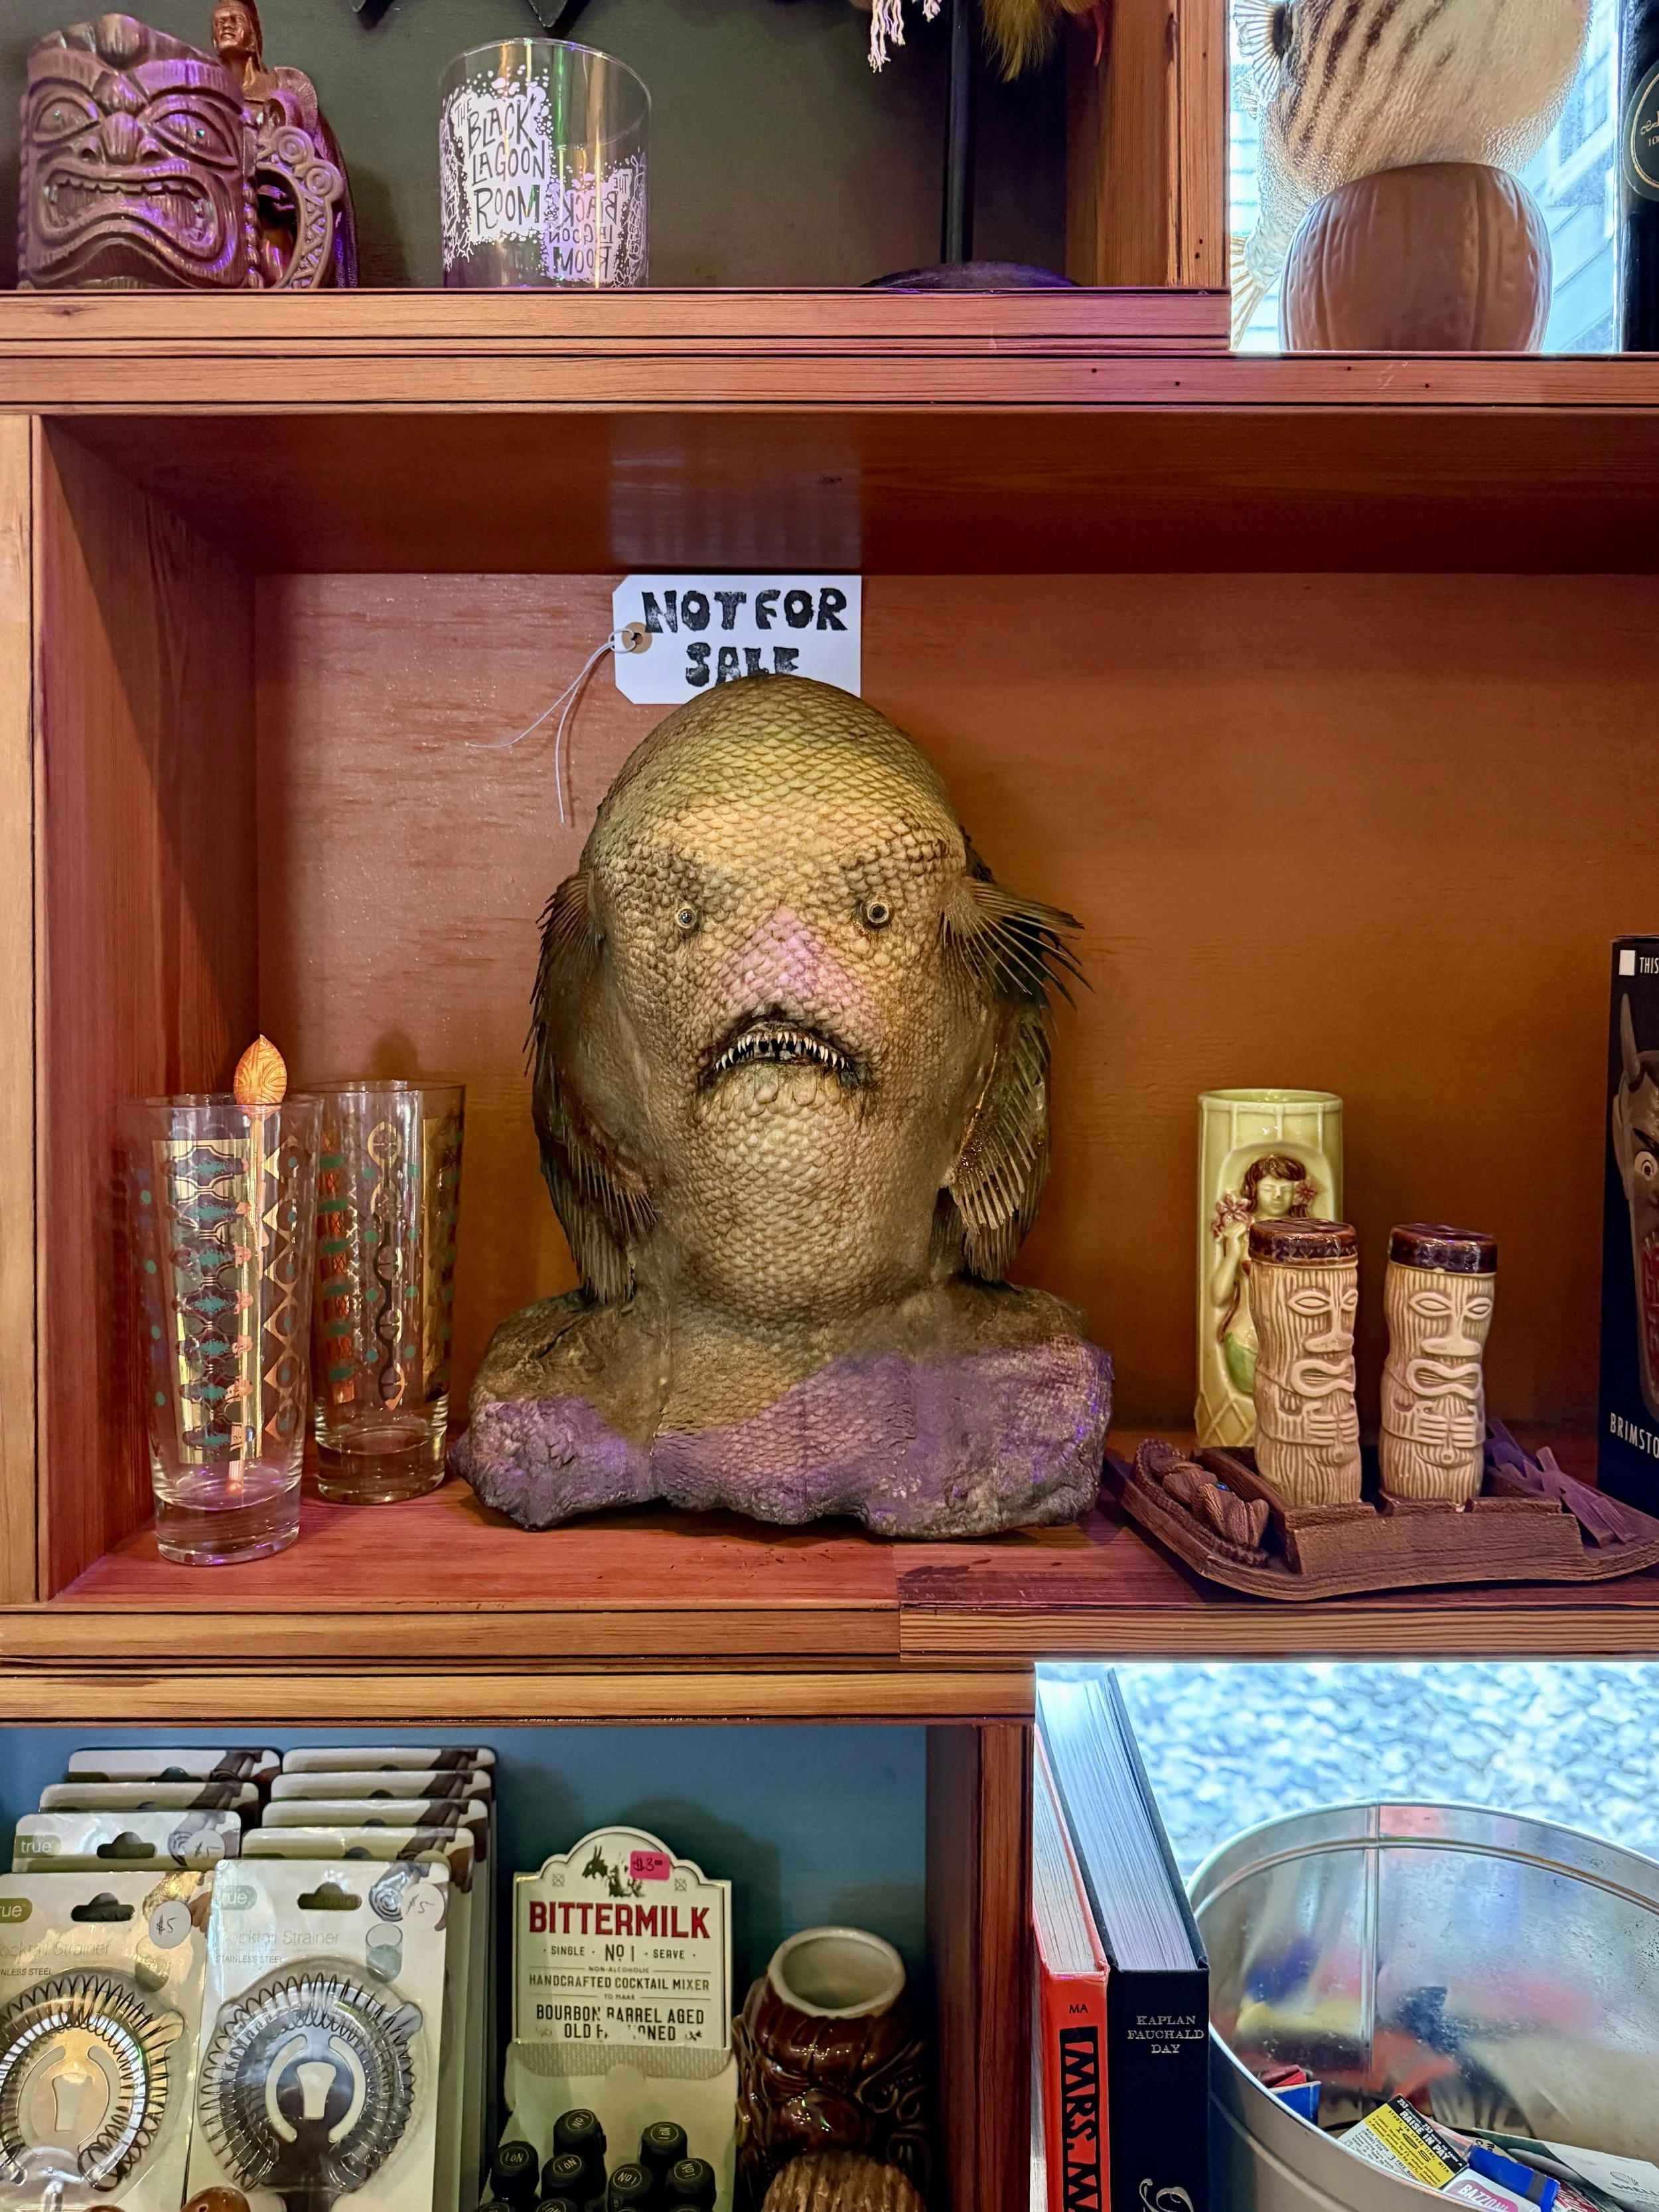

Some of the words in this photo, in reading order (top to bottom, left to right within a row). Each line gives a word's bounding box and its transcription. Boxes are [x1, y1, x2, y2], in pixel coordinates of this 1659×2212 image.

[455, 98, 472, 128] THE
[467, 94, 538, 159] BLACK
[472, 140, 545, 186] LAGOON
[473, 184, 540, 235] ROOM
[642, 590, 747, 633] NOT
[755, 588, 848, 630] FOR
[685, 642, 800, 688] SALE
[1639, 956, 1659, 974] THIS
[21, 1840, 51, 1852] true
[156, 1914, 177, 1936] $5
[530, 1901, 711, 1939] BITTERMILK
[283, 1929, 340, 1945] Strainer
[54, 1941, 110, 1956] Strainer
[551, 1946, 585, 1956] SINGLE
[653, 1949, 685, 1959] SERVE
[530, 1974, 611, 1988] HANDCRAFTED
[615, 1977, 669, 1990] COCKTAIL
[672, 1978, 709, 1991] MIXER
[536, 2004, 601, 2022] BOURBON
[668, 2009, 703, 2024] AGED
[1069, 2004, 1088, 2014] MA
[1136, 2015, 1196, 2025] KAPLAN
[565, 2023, 591, 2039] OLD
[1127, 2029, 1204, 2039] FAUCHALD
[1151, 2044, 1181, 2053] DAY
[1396, 2097, 1409, 2109] 253
[1421, 2122, 1433, 2134] 253
[1399, 2109, 1424, 2135] RAISE
[1421, 2132, 1435, 2146] IN
[1431, 2143, 1450, 2162] PAY
[1410, 2132, 1423, 2146] SPARE
